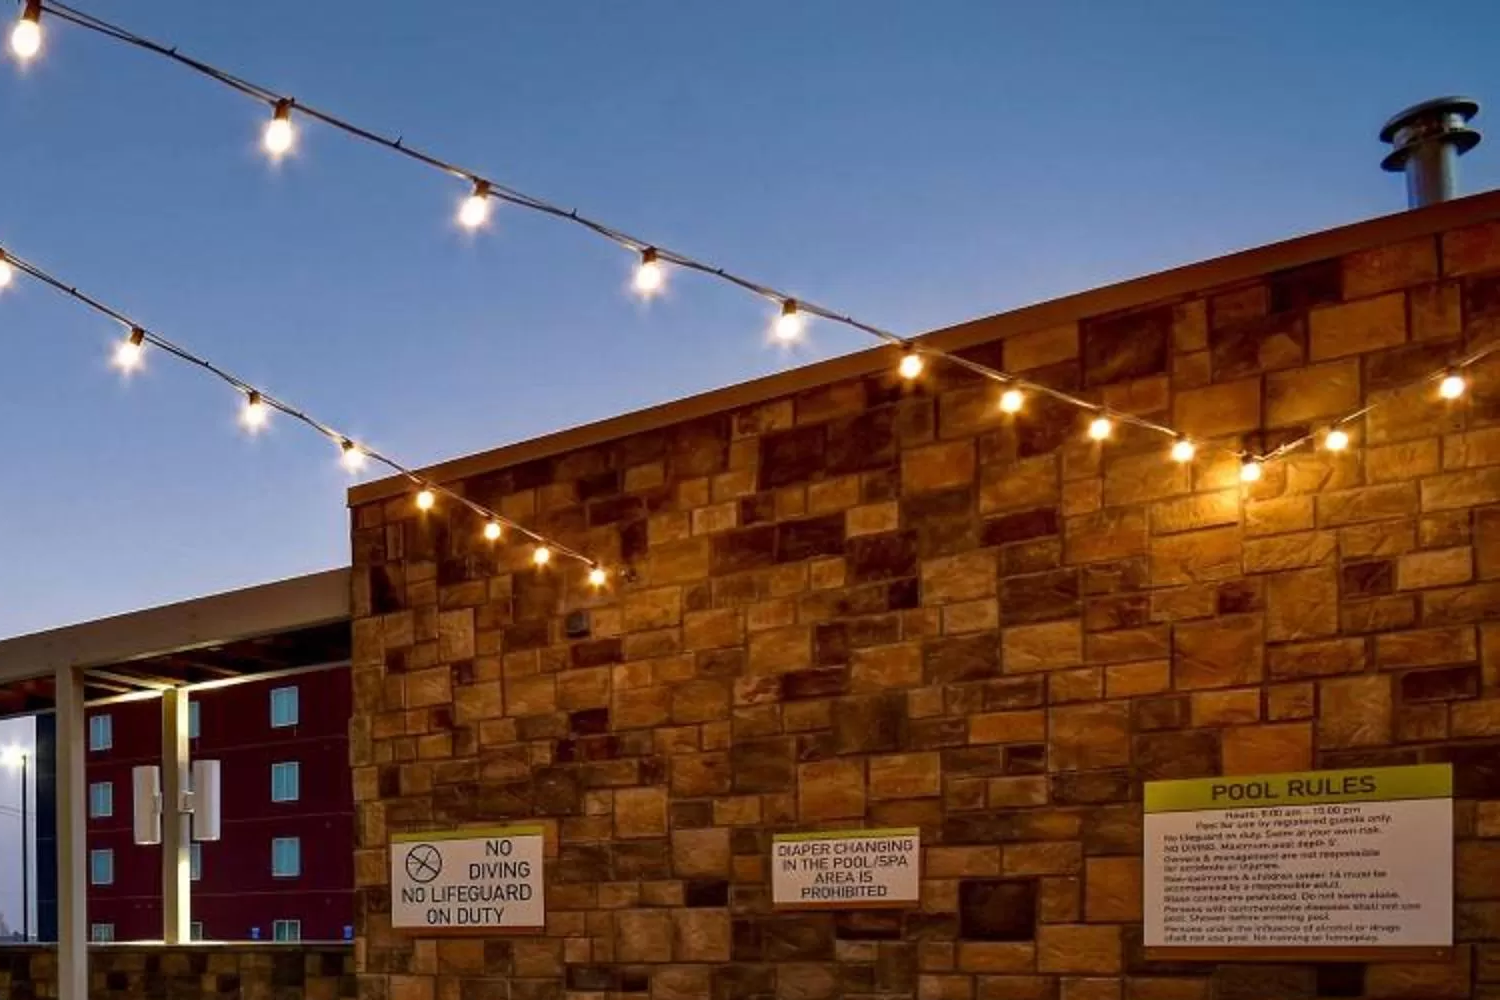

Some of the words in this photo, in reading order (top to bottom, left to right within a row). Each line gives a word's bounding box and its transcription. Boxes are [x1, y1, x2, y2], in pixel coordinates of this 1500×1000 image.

[1212, 782, 1280, 800] POOL
[1288, 776, 1376, 796] RULES
[485, 840, 512, 856] NO
[778, 844, 830, 857] DIAPER
[833, 840, 913, 855] CHANGING
[469, 862, 530, 880] DIVING
[783, 859, 796, 870] IN
[802, 857, 829, 870] THE
[833, 855, 908, 869] POOL/SPA
[815, 871, 855, 884] AREA
[860, 871, 872, 882] IS
[402, 887, 424, 903] NO
[431, 884, 532, 903] LIFEGUARD
[802, 885, 887, 899] PROHIBITED
[427, 908, 450, 924] ON
[458, 907, 504, 924] DUTY
